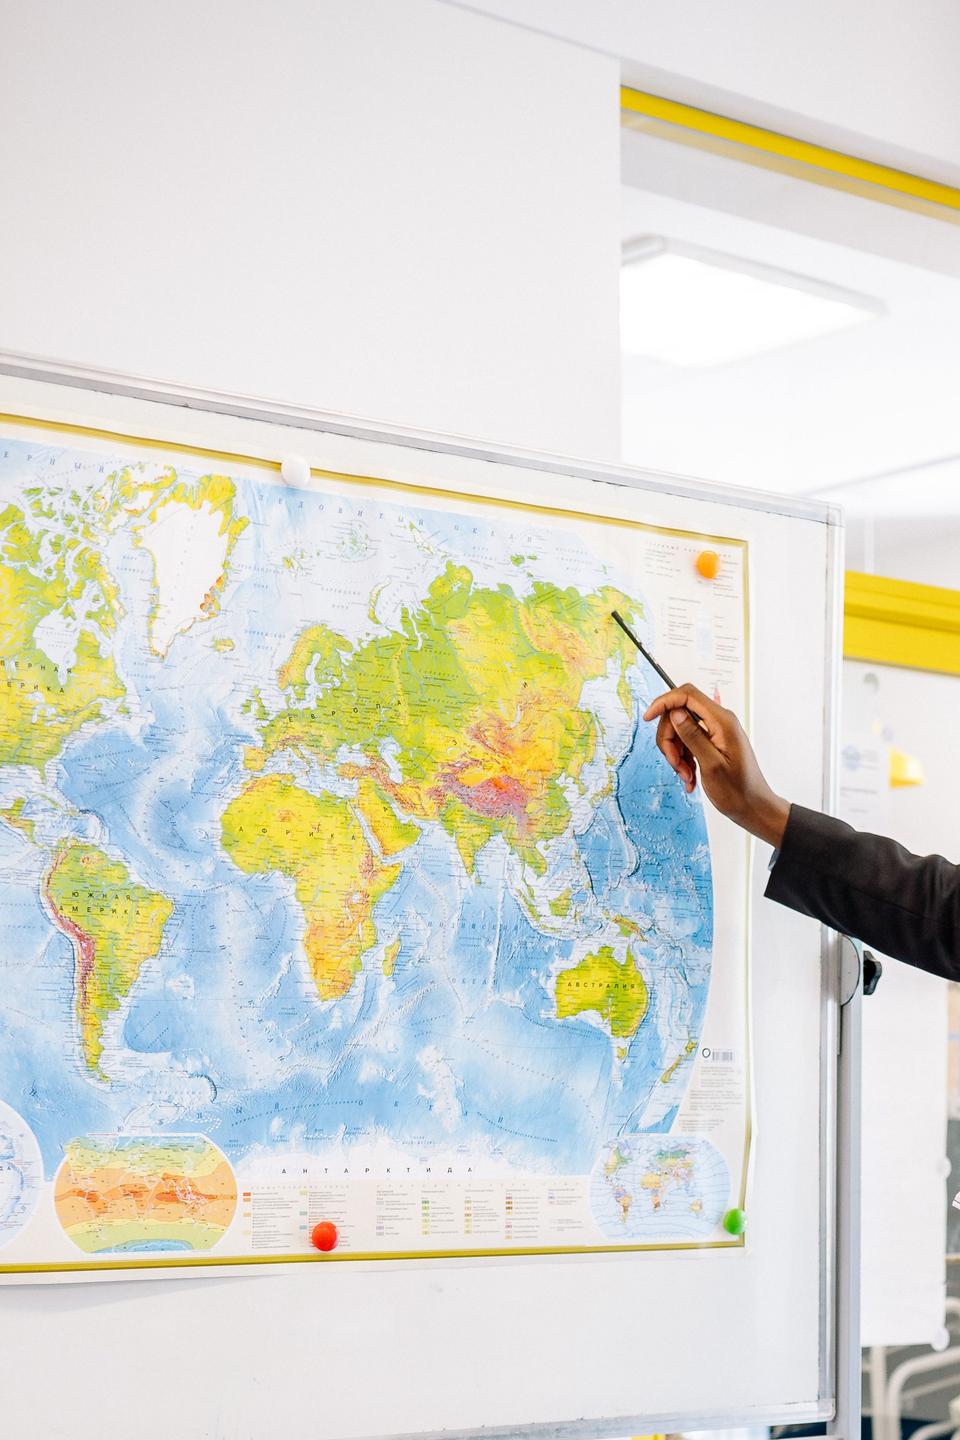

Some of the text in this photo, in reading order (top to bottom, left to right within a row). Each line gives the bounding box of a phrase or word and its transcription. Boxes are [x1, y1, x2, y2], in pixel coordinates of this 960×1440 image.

[238, 826, 356, 841] АФРИКА
[71, 891, 131, 901] ЮЖНАЯ
[58, 905, 140, 916] АМЕРИКА
[567, 981, 635, 990] АВСТРАЛИЯ
[281, 1166, 473, 1175] АНТАРКТИДА
